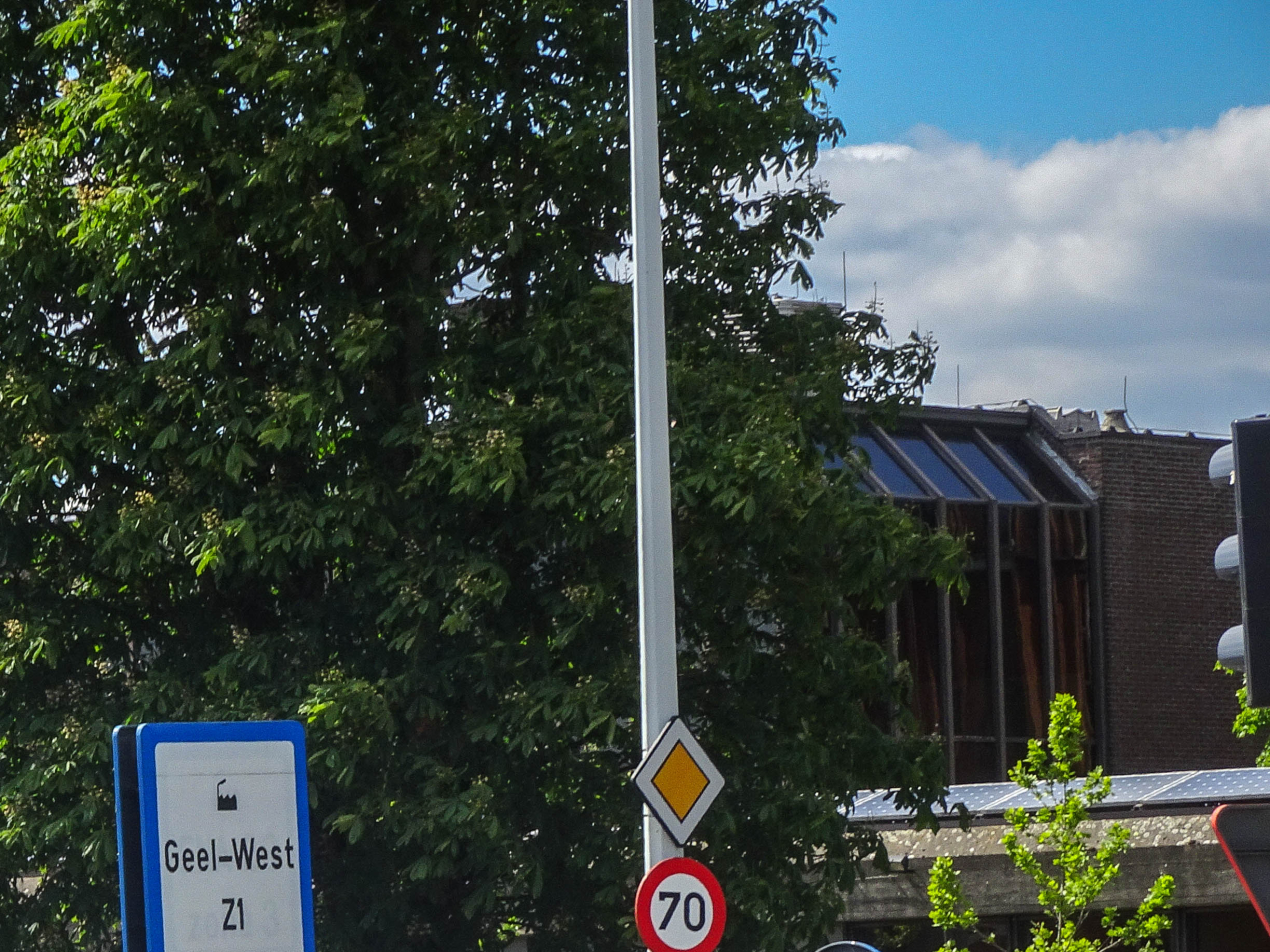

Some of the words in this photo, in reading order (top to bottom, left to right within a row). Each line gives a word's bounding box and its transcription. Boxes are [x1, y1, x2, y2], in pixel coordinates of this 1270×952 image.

[164, 837, 295, 873] Geel-West
[221, 897, 245, 931] Z1
[658, 891, 706, 932] 70
